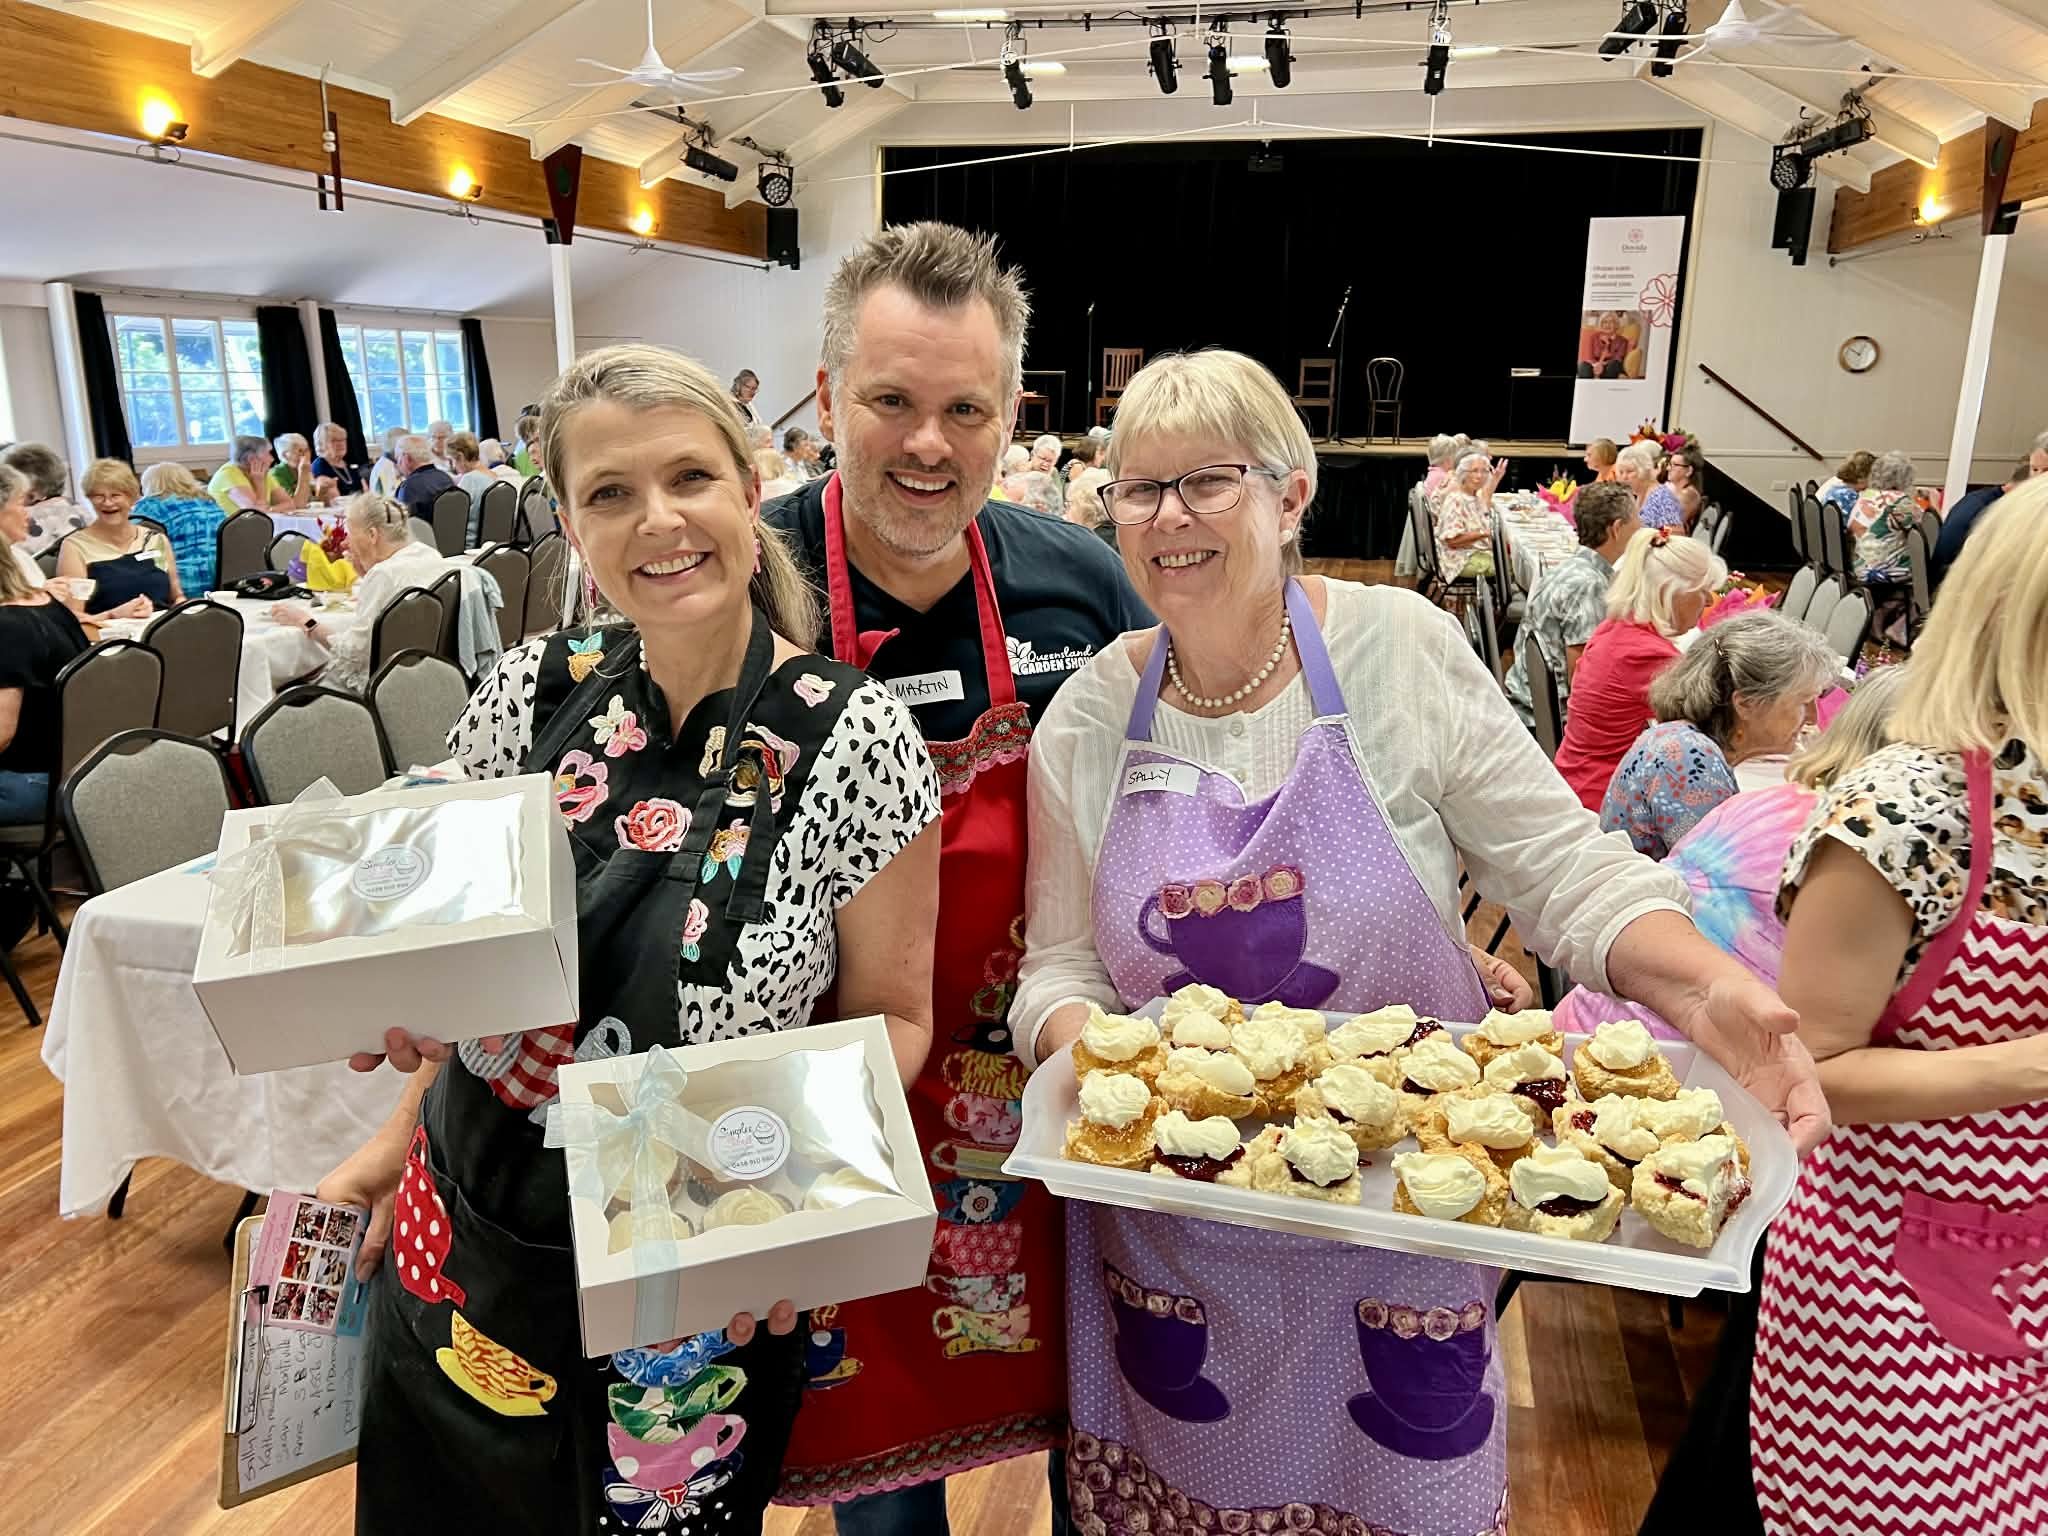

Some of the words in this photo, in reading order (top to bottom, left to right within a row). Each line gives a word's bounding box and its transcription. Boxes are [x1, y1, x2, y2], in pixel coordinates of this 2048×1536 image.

[1027, 643, 1094, 662] Queensland
[1020, 658, 1065, 675] GARDEN
[895, 676, 949, 699] MARTIN
[1128, 768, 1172, 787] SALLY
